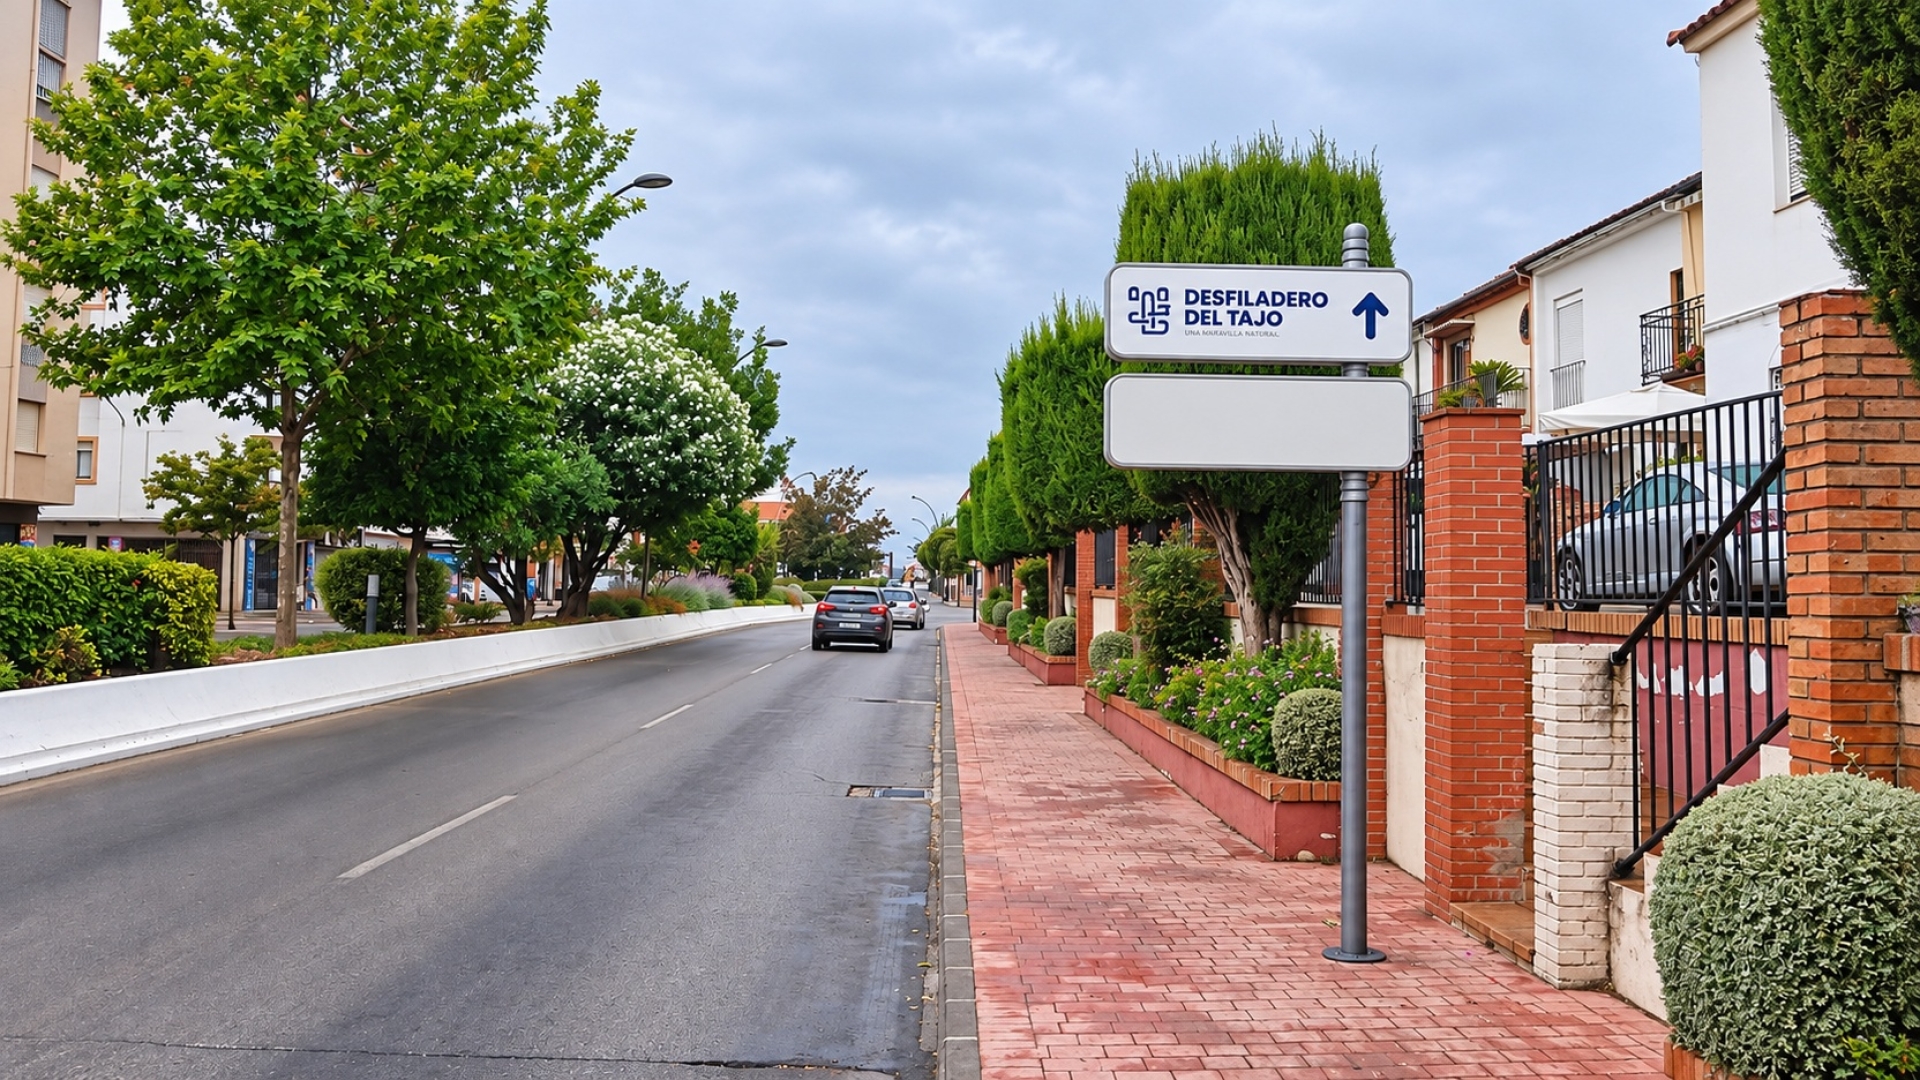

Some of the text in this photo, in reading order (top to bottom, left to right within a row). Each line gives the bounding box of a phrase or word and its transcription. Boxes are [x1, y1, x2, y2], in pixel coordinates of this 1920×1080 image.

[1184, 288, 1329, 308] DESFILADERO
[1184, 309, 1283, 327] DEL TAJO
[1184, 329, 1201, 337] UNA
